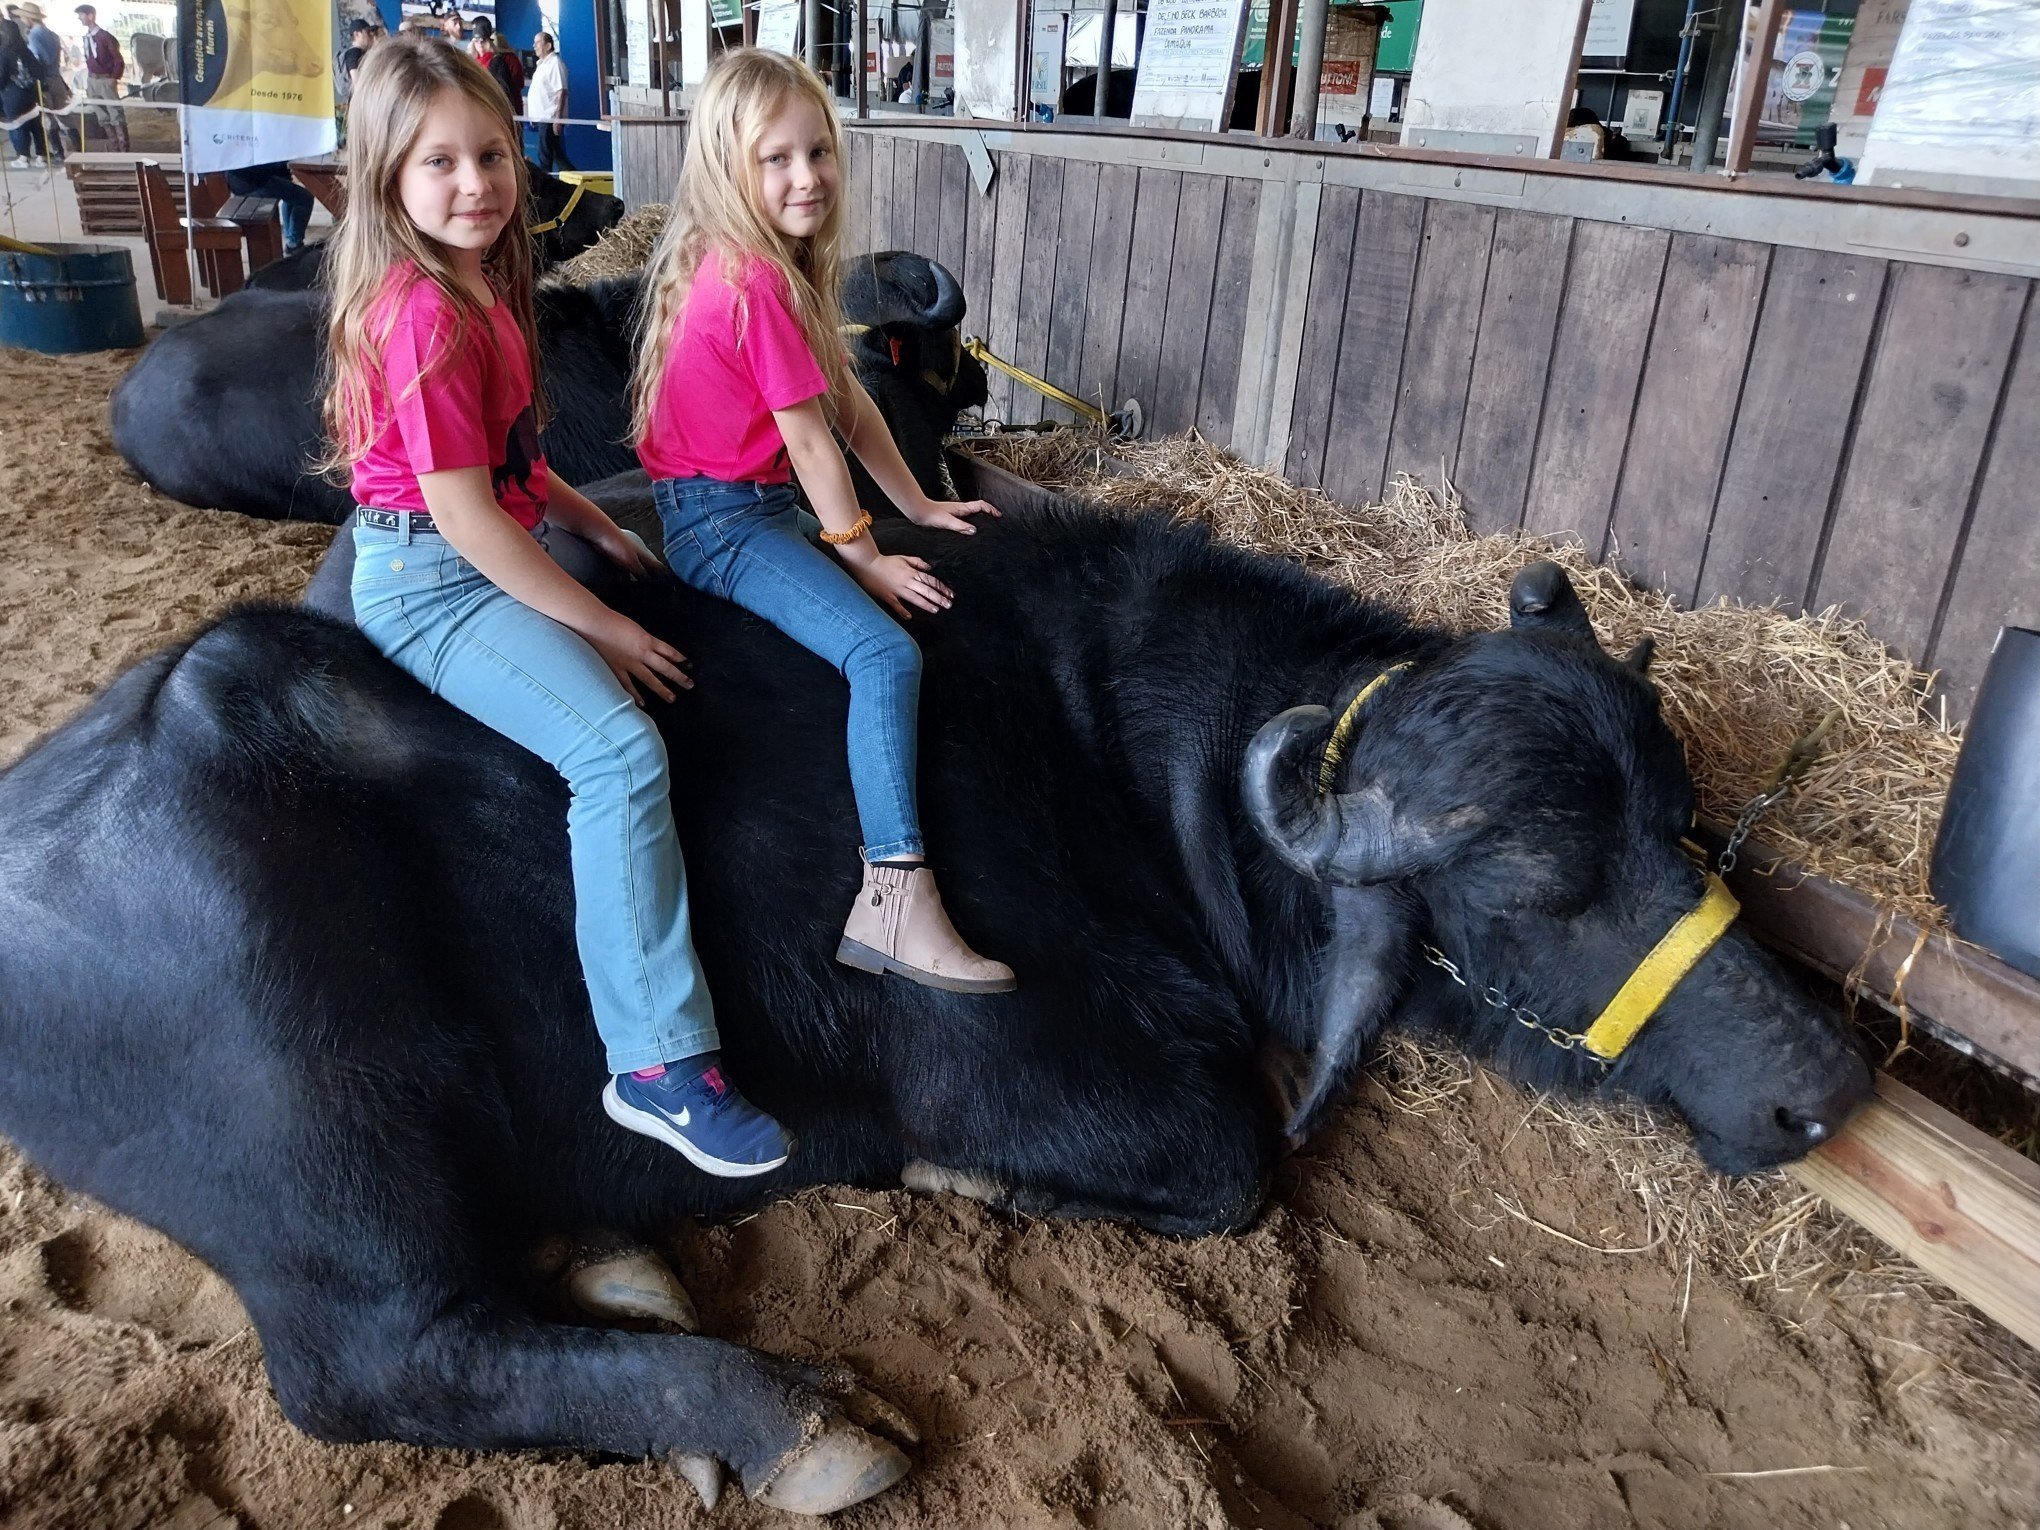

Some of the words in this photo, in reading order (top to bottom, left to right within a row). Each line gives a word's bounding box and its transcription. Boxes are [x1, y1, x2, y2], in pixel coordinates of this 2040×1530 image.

[207, 20, 215, 55] Murrah
[1180, 25, 1214, 34] PANORAMA
[196, 39, 205, 82] Genética
[251, 89, 278, 99] Desde
[281, 91, 303, 102] 1976
